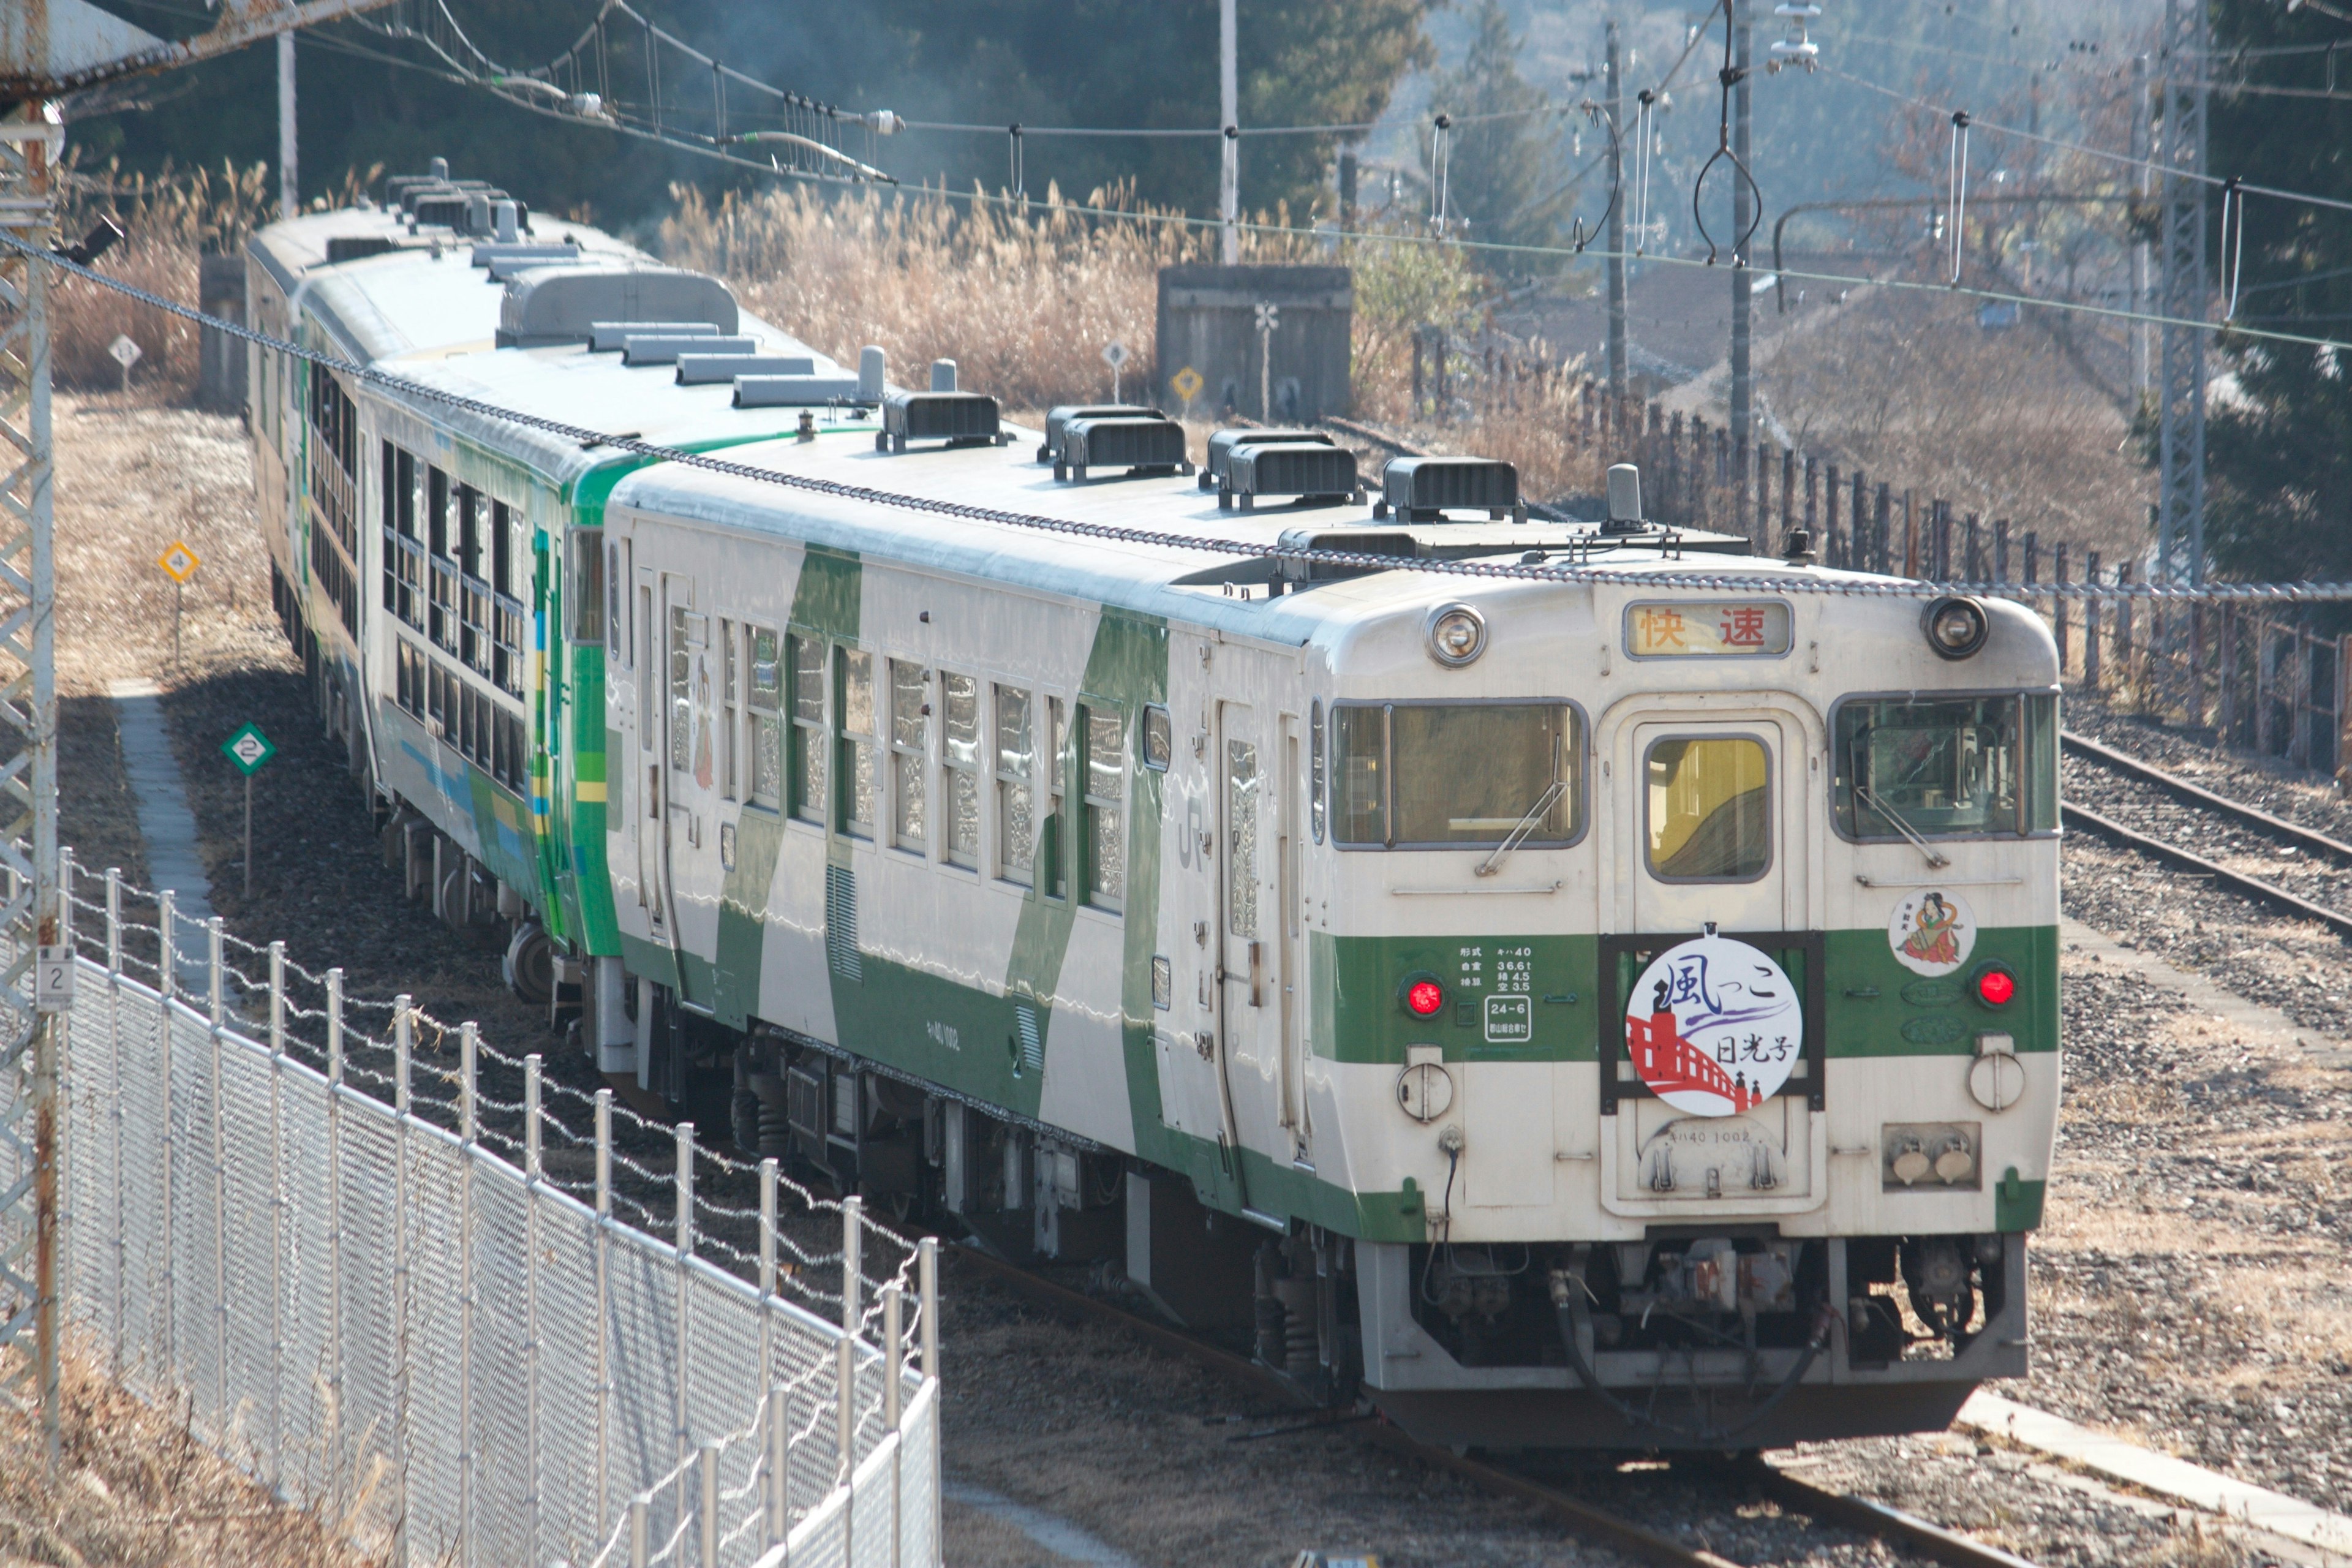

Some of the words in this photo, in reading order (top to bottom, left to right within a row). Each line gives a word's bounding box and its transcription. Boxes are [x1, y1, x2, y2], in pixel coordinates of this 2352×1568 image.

[1640, 608, 1765, 647] 快速
[240, 739, 257, 757] 2
[1178, 796, 1202, 872] JR
[1460, 947, 1482, 957] 形式
[1498, 948, 1531, 957] キハ40
[1461, 962, 1482, 971] 自重
[51, 968, 63, 990] 2
[1512, 972, 1530, 981] 4.5
[1660, 954, 1776, 1015] 風っこ
[1498, 982, 1509, 992] 空
[1512, 982, 1530, 992] 3.5
[1491, 1003, 1526, 1014] 24-6
[1717, 1033, 1793, 1065] 日光号
